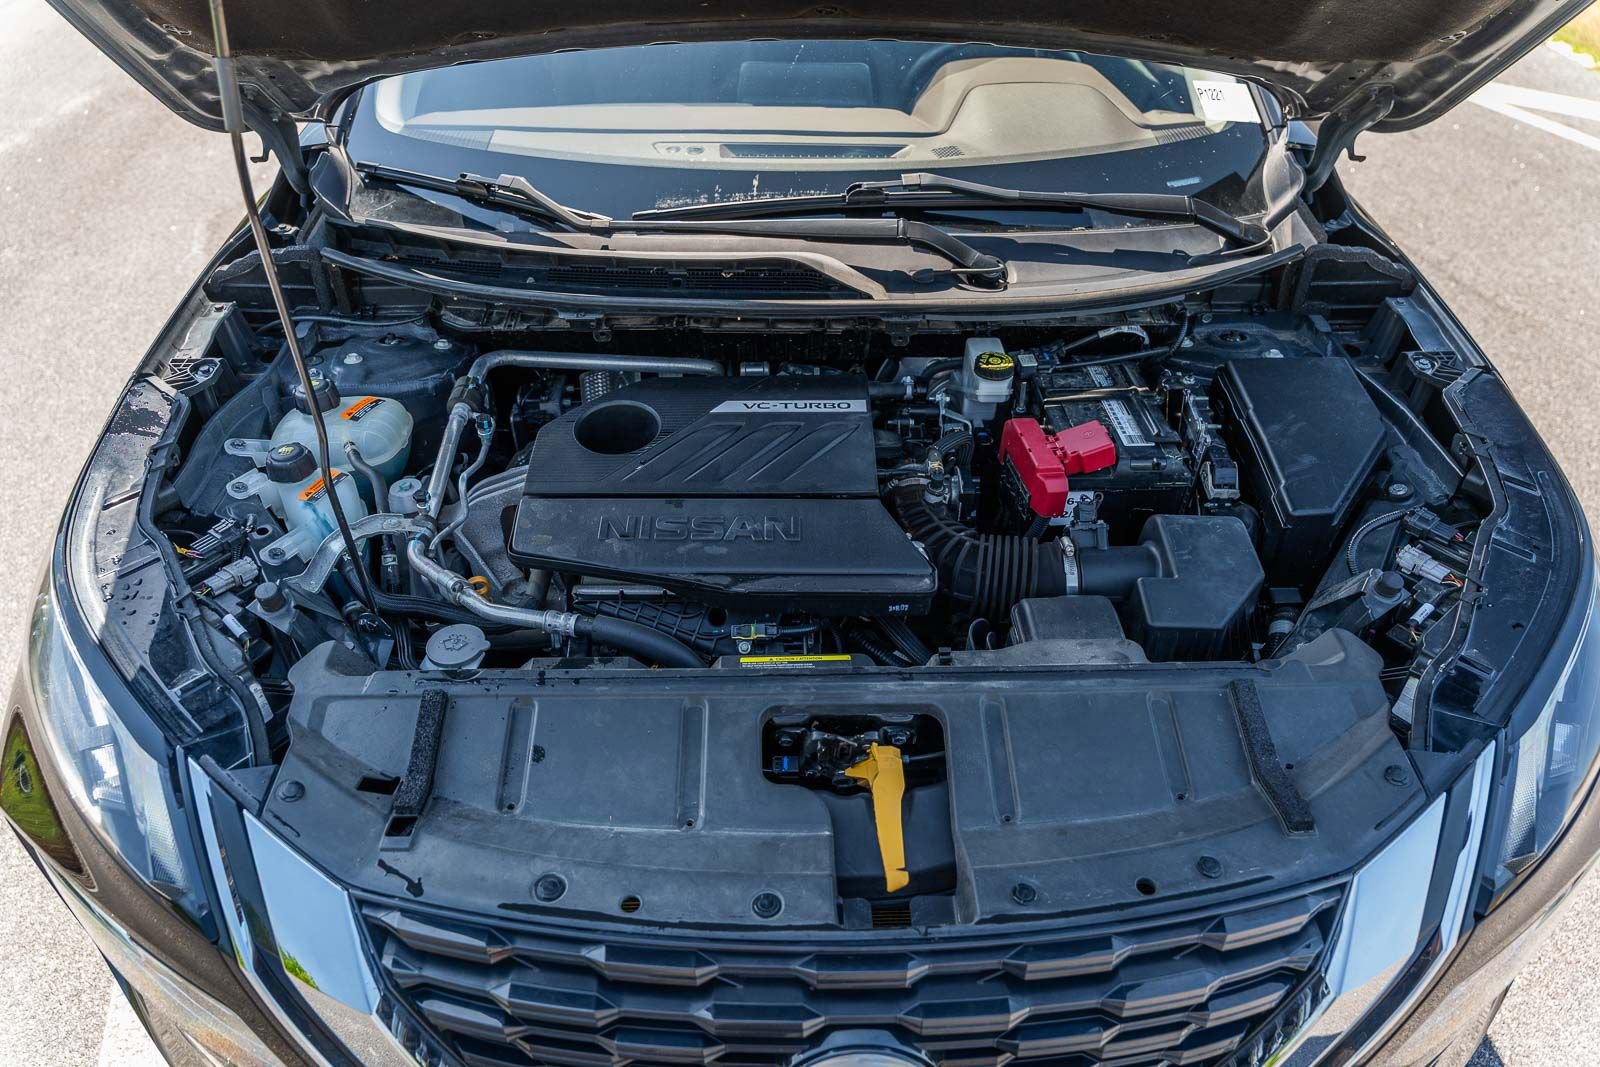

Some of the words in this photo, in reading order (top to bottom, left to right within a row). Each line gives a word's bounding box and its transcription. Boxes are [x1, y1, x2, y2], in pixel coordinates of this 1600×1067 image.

[1197, 87, 1225, 101] P1221
[743, 402, 851, 410] VC-TURBO
[597, 515, 802, 542] NISSAN
